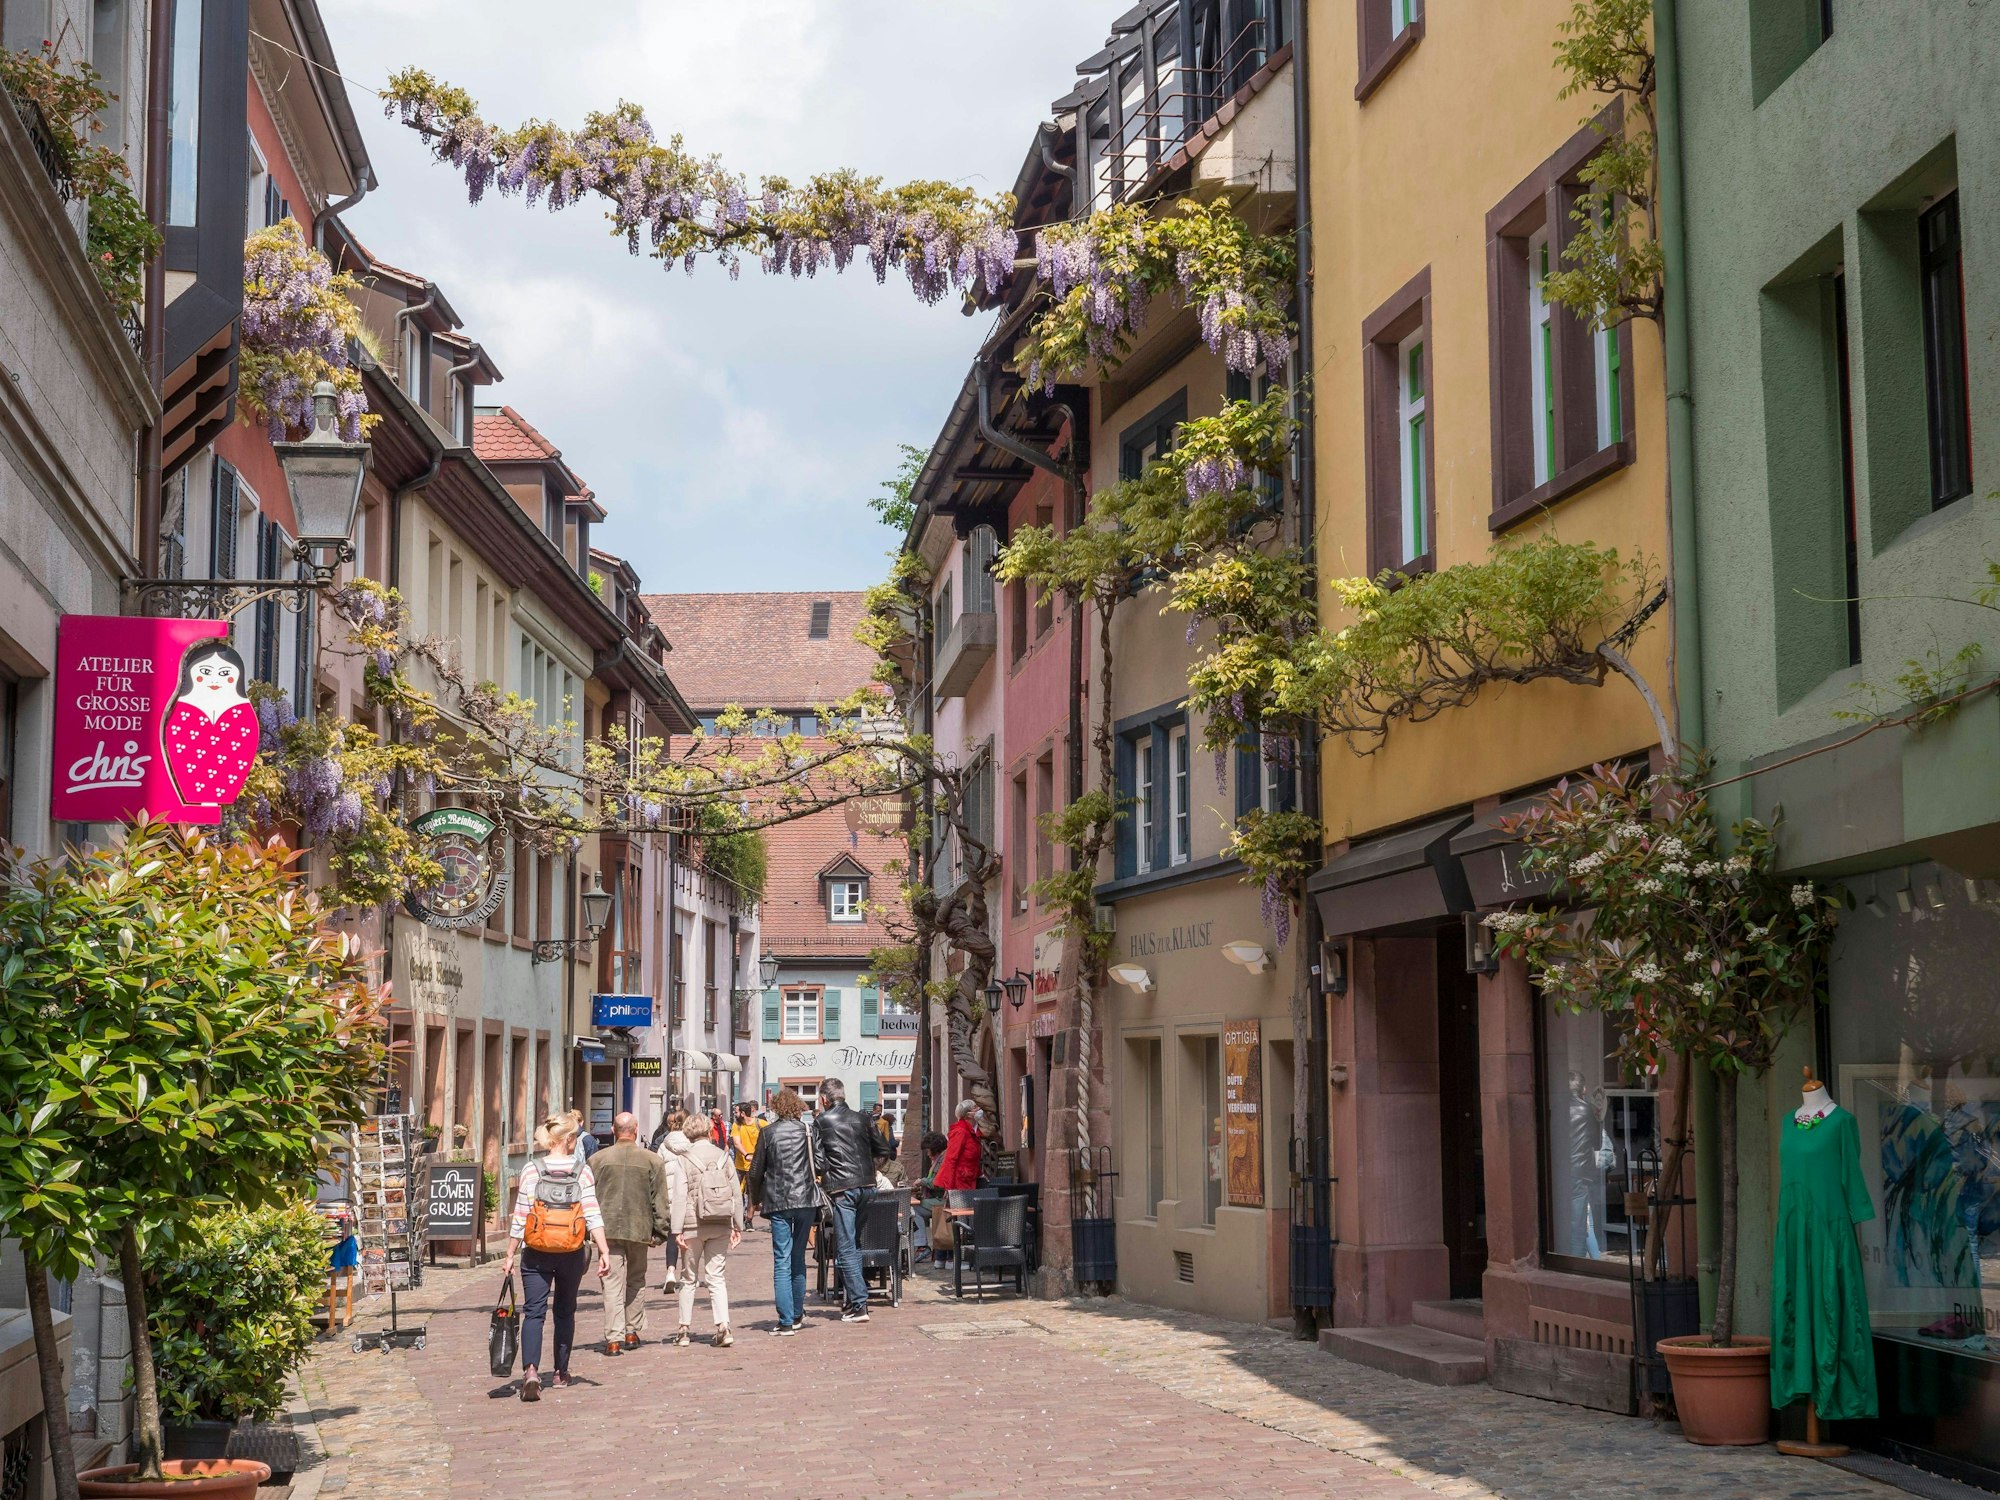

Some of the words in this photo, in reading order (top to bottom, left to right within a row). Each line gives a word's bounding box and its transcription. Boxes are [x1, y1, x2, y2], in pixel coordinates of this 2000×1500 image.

[77, 656, 154, 673] ATELIER
[96, 673, 135, 692] FÜR
[76, 694, 151, 712] GROSSE
[83, 714, 142, 731] MODE
[68, 740, 152, 782] chris
[1130, 931, 1156, 957] HAUS
[1172, 922, 1213, 951] KLAUSE
[610, 1005, 650, 1018] philoro
[1225, 1031, 1259, 1046] ORTIGIA
[631, 1062, 661, 1070] MIRJAM
[832, 1046, 916, 1070] Wirtschaf
[1227, 1073, 1243, 1086] DÜFTE
[1228, 1090, 1236, 1100] DIE
[1228, 1101, 1257, 1114] VERFÜHREN
[431, 1182, 474, 1199] LÖWEN
[429, 1202, 474, 1217] GRUBE
